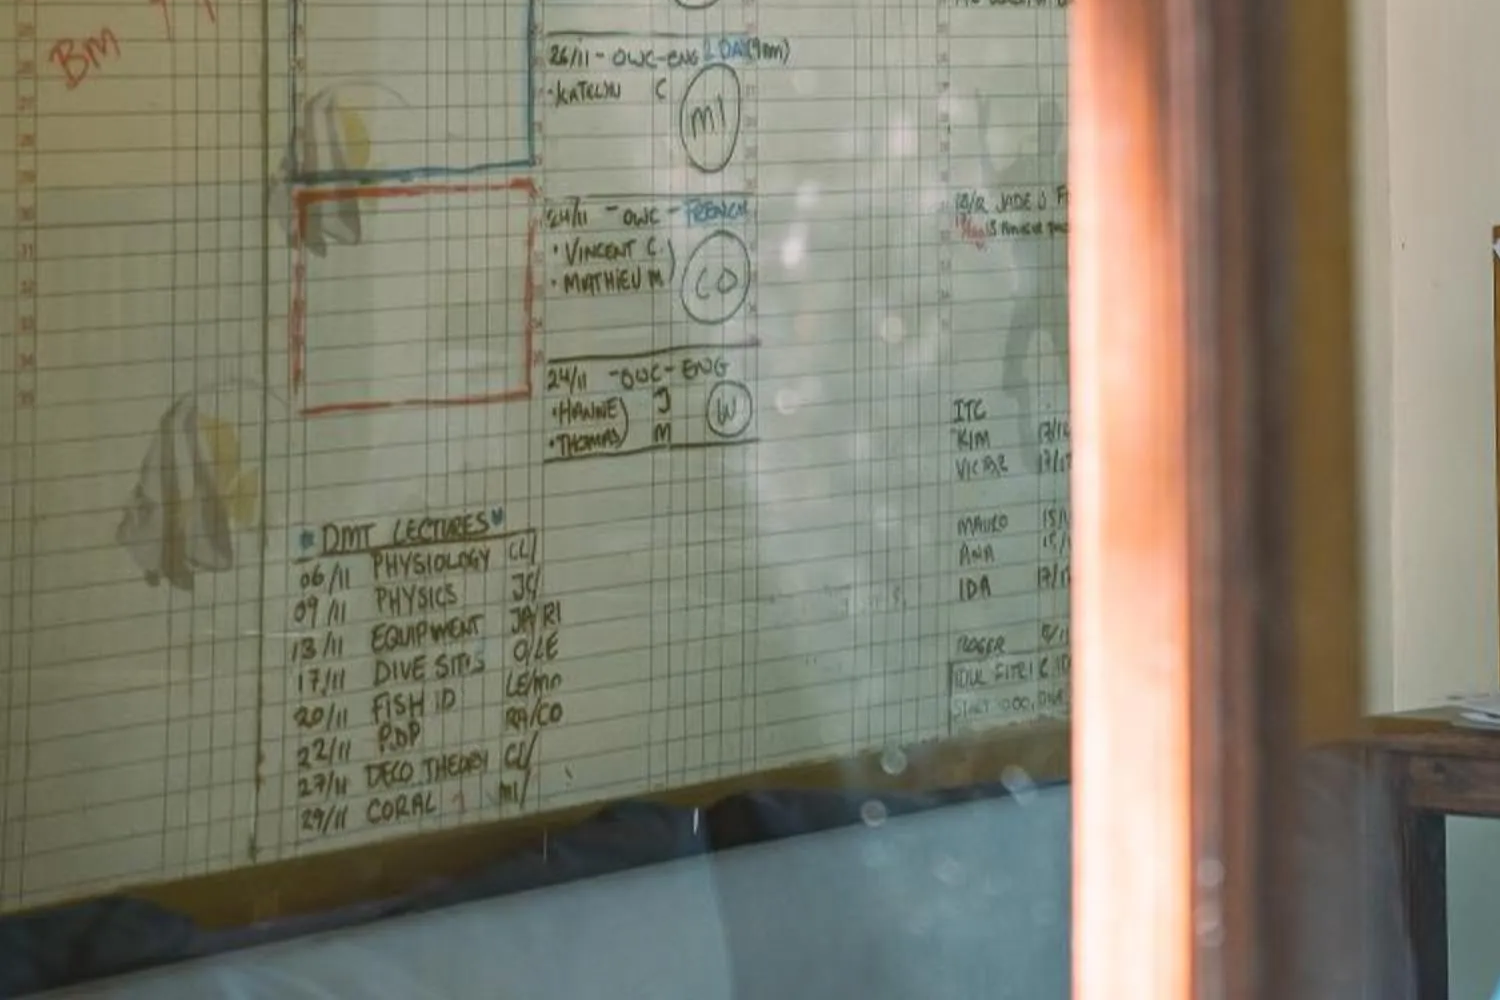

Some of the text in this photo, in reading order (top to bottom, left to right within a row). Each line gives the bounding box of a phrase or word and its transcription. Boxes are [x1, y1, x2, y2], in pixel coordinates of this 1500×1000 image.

[565, 237, 645, 263] VINCENT
[957, 427, 992, 452] KIM
[393, 510, 490, 546] LECTURES
[300, 546, 492, 595] 06/11 PHYSIOLOGY
[376, 582, 459, 616] PHYSICS
[958, 576, 993, 602] IDA
[371, 613, 485, 653] EQUIPMENT
[373, 653, 426, 687] DIVE
[371, 688, 425, 724] FISH
[434, 687, 457, 715] ID
[421, 748, 490, 781] THEORY
[365, 791, 438, 825] CORAL
